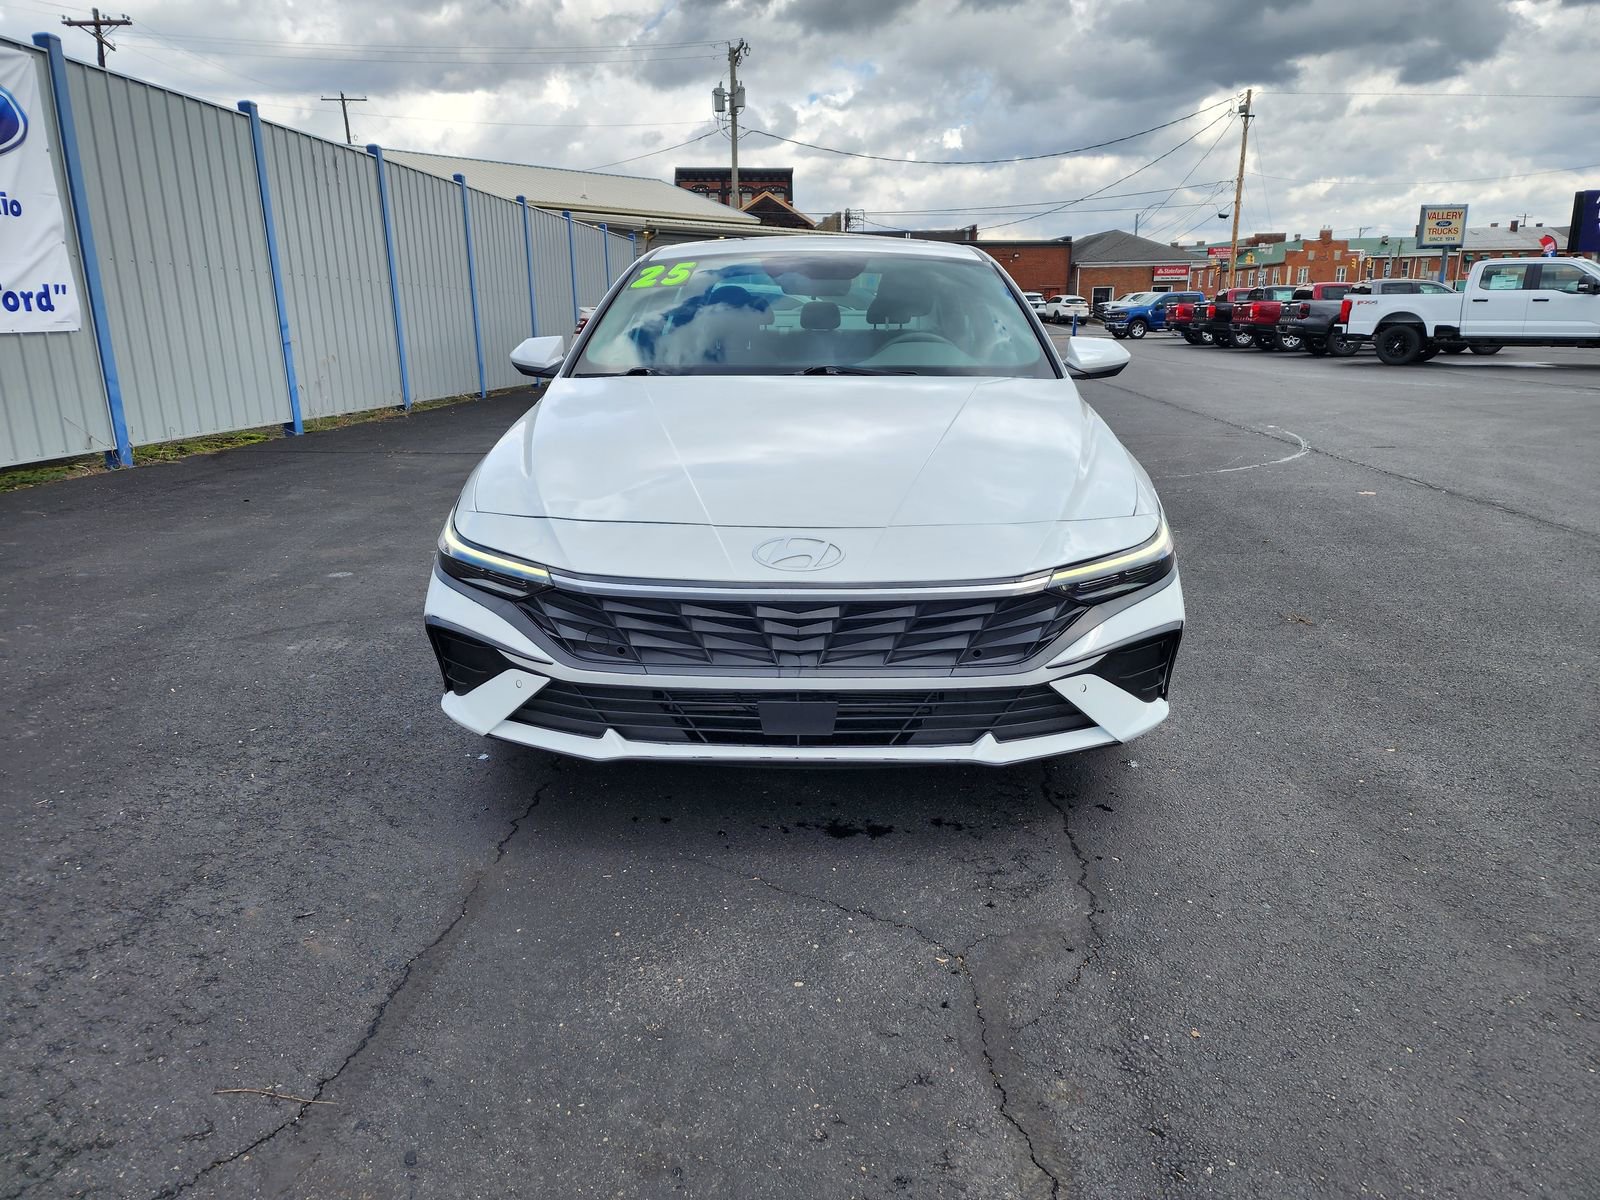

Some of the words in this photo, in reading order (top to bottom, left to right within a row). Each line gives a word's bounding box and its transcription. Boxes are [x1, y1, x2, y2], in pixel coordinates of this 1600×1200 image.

[0, 192, 21, 217] io
[1427, 211, 1463, 220] VALLERY
[1428, 227, 1459, 235] TRUCKS
[630, 261, 698, 289] 25
[0, 284, 66, 312] ord"
